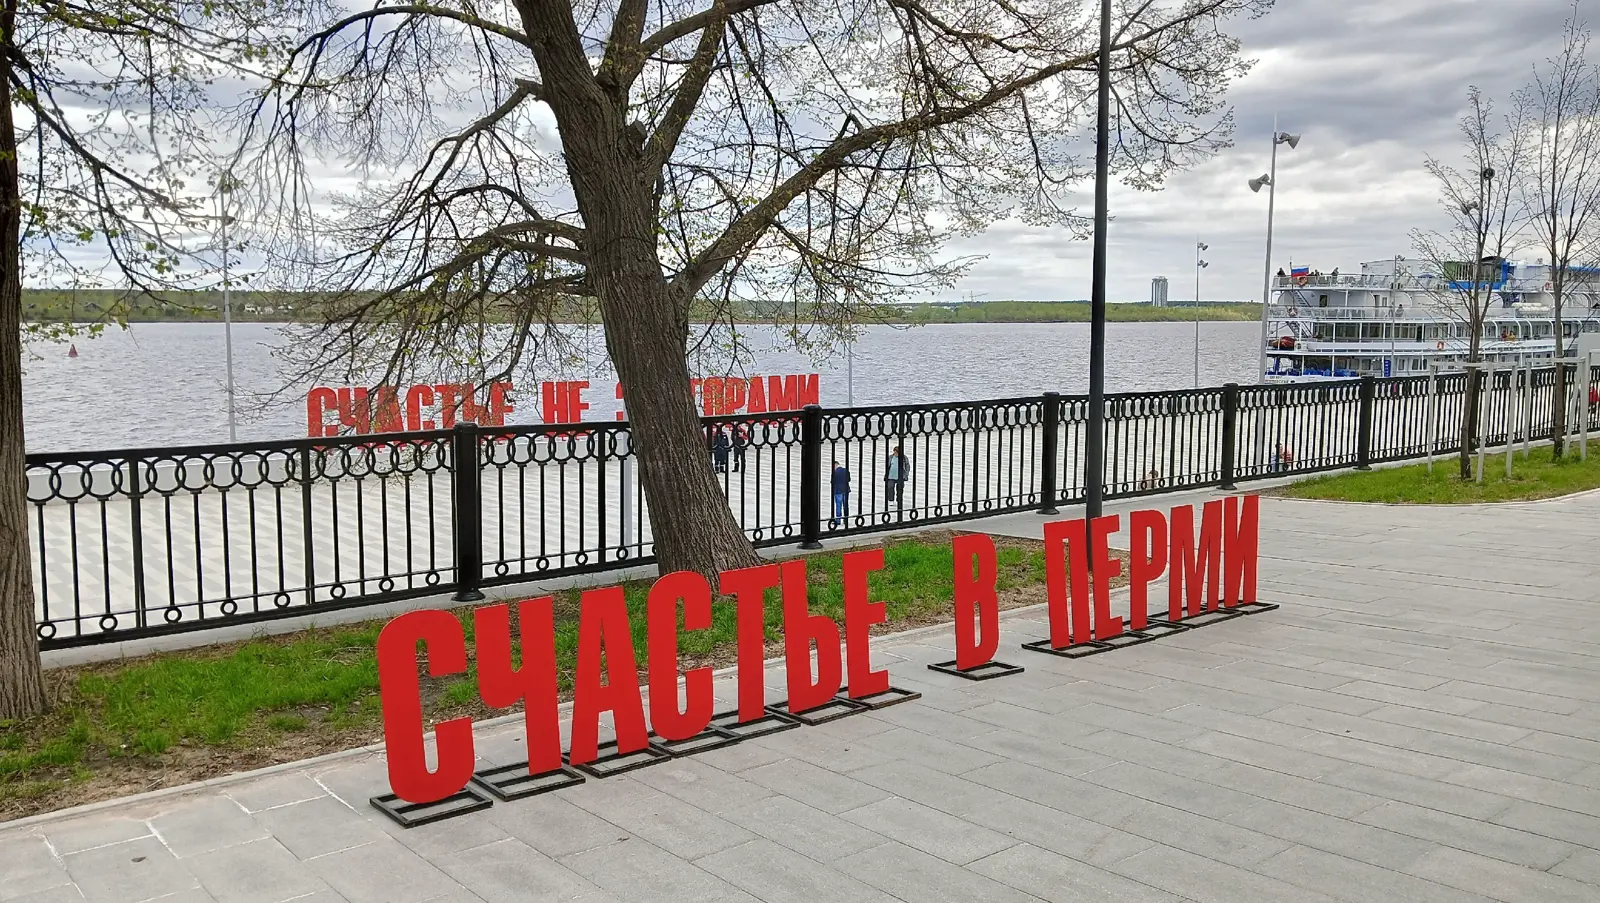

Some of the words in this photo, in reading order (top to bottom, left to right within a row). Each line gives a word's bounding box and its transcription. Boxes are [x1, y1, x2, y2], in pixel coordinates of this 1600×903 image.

[542, 380, 590, 438] НЕ
[376, 548, 890, 804] СЧАСТЬЕ
[953, 533, 1000, 671] В
[1043, 494, 1260, 649] ПЕРМИ
